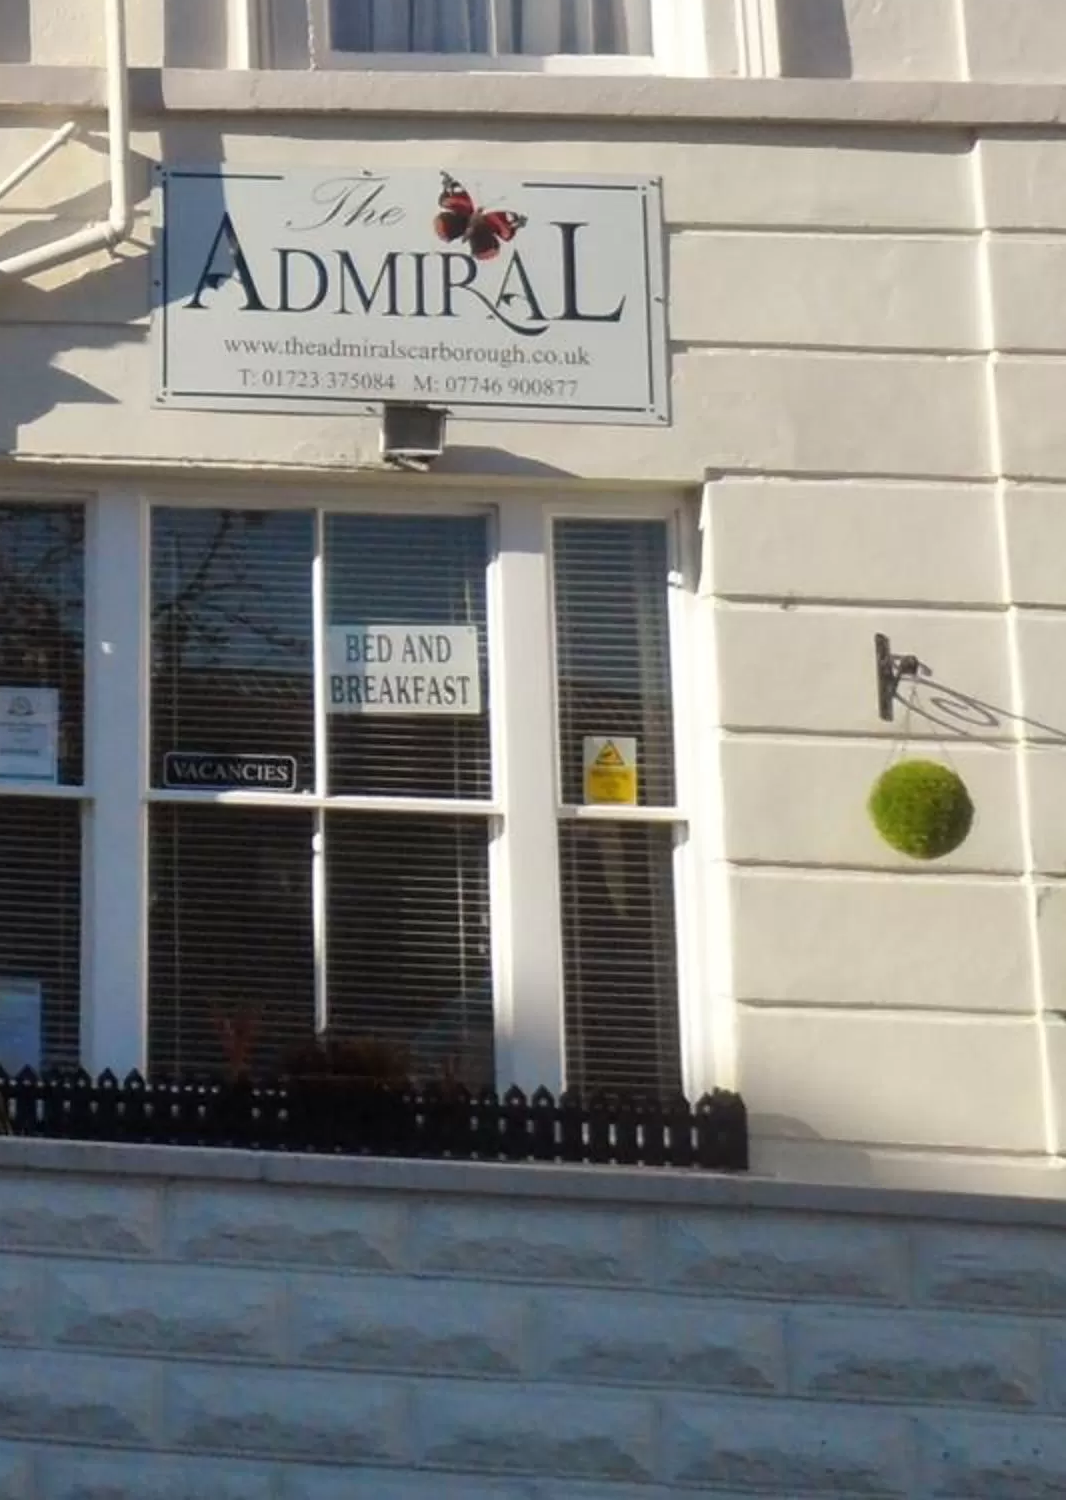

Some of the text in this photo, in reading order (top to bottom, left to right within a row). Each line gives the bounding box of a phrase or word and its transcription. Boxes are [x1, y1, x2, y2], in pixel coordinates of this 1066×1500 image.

[285, 175, 407, 232] The
[182, 211, 627, 337] ADMIRAL
[223, 336, 591, 368] www.theadmiralscarborough.co.uk
[238, 368, 579, 397] T: 01723 375084 M: 07746 900877
[345, 633, 452, 663] BED AND
[330, 674, 471, 705] BREAKFAST
[173, 760, 289, 781] VACANCIES
